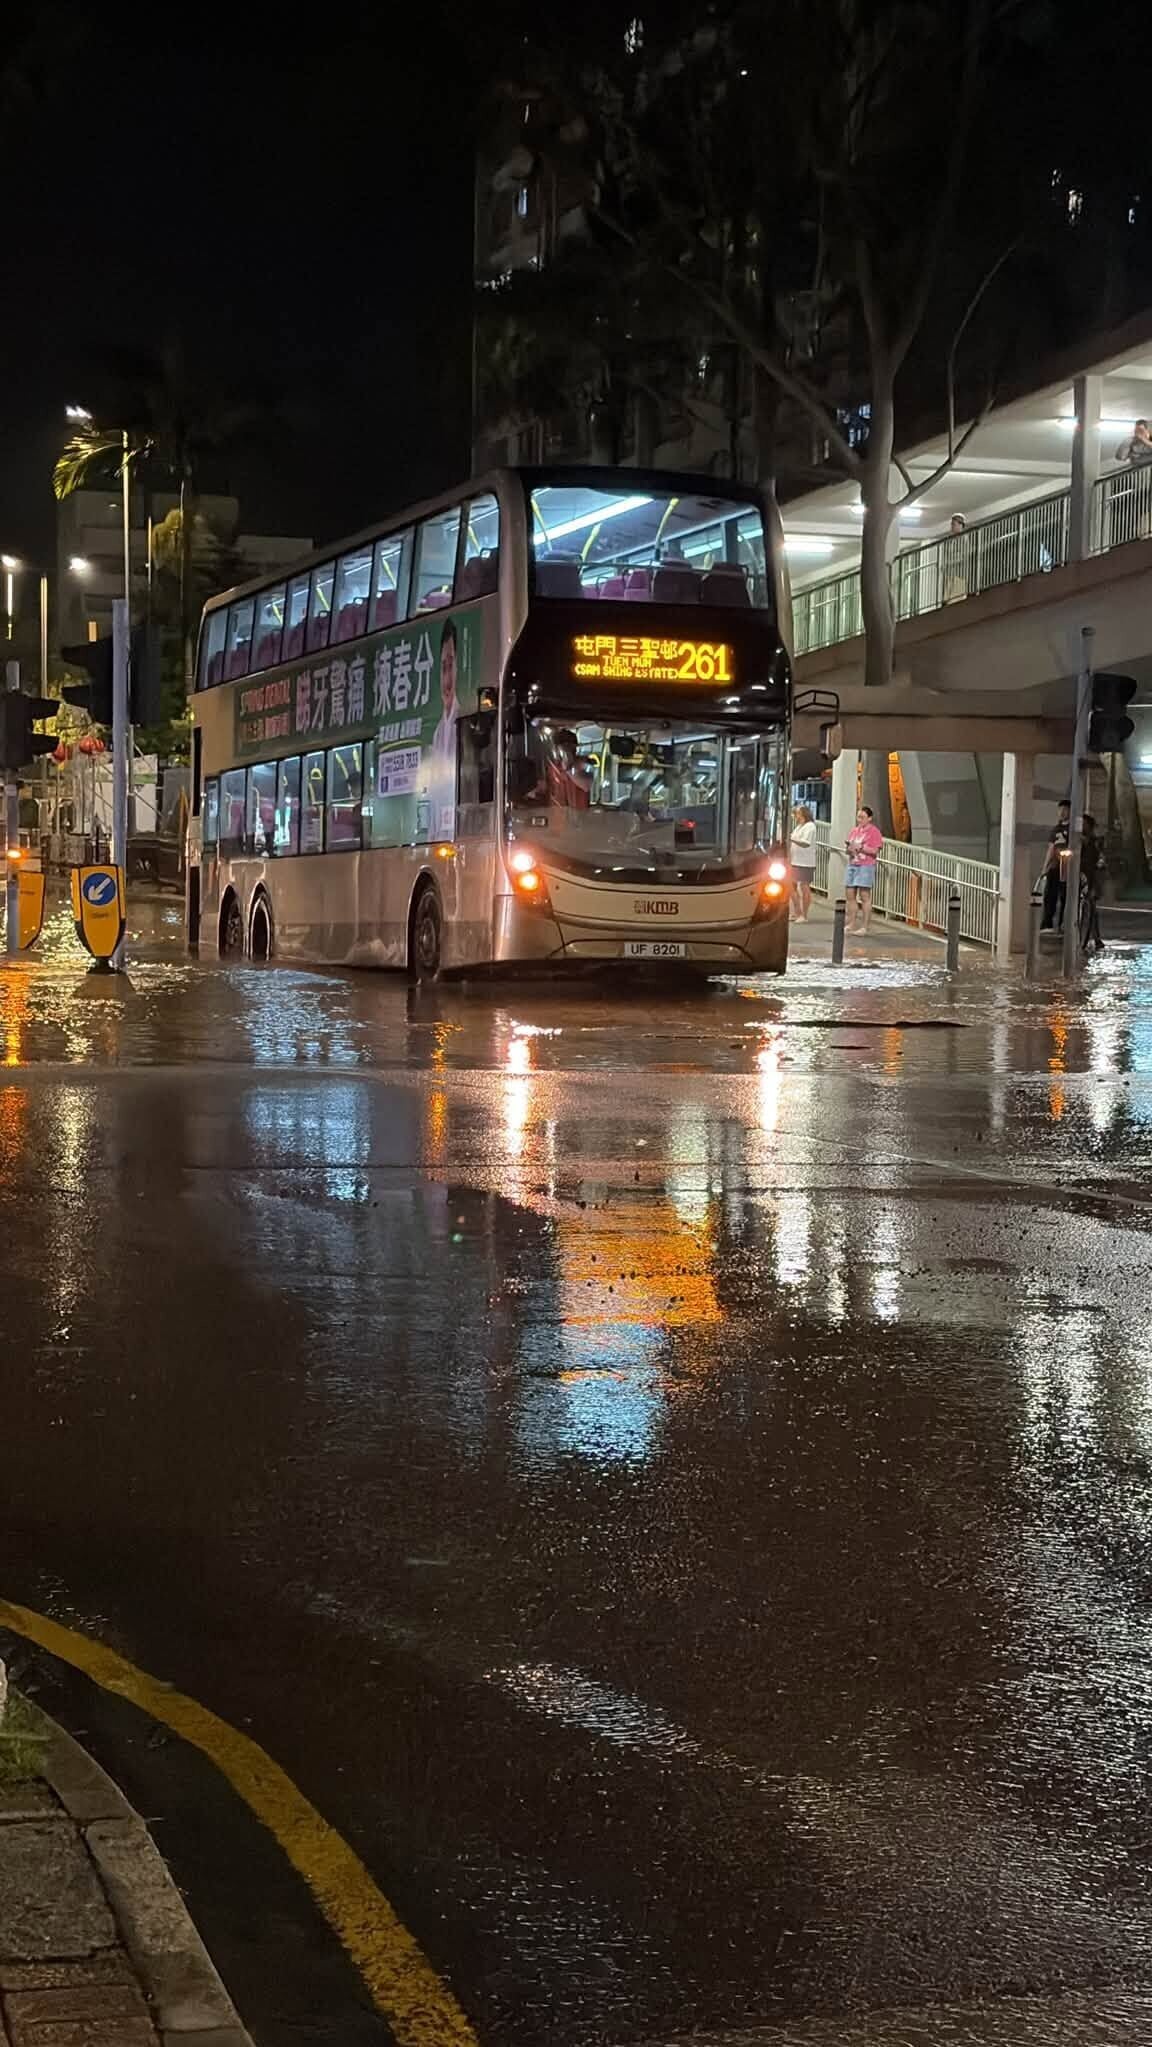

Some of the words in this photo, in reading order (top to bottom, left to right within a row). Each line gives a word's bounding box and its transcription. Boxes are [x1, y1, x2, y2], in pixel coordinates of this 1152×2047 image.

[574, 634, 678, 660] 屯門三聖邨
[678, 643, 731, 680] 261
[647, 901, 679, 915] KMB
[631, 944, 647, 954] UF
[653, 944, 680, 955] 8201
